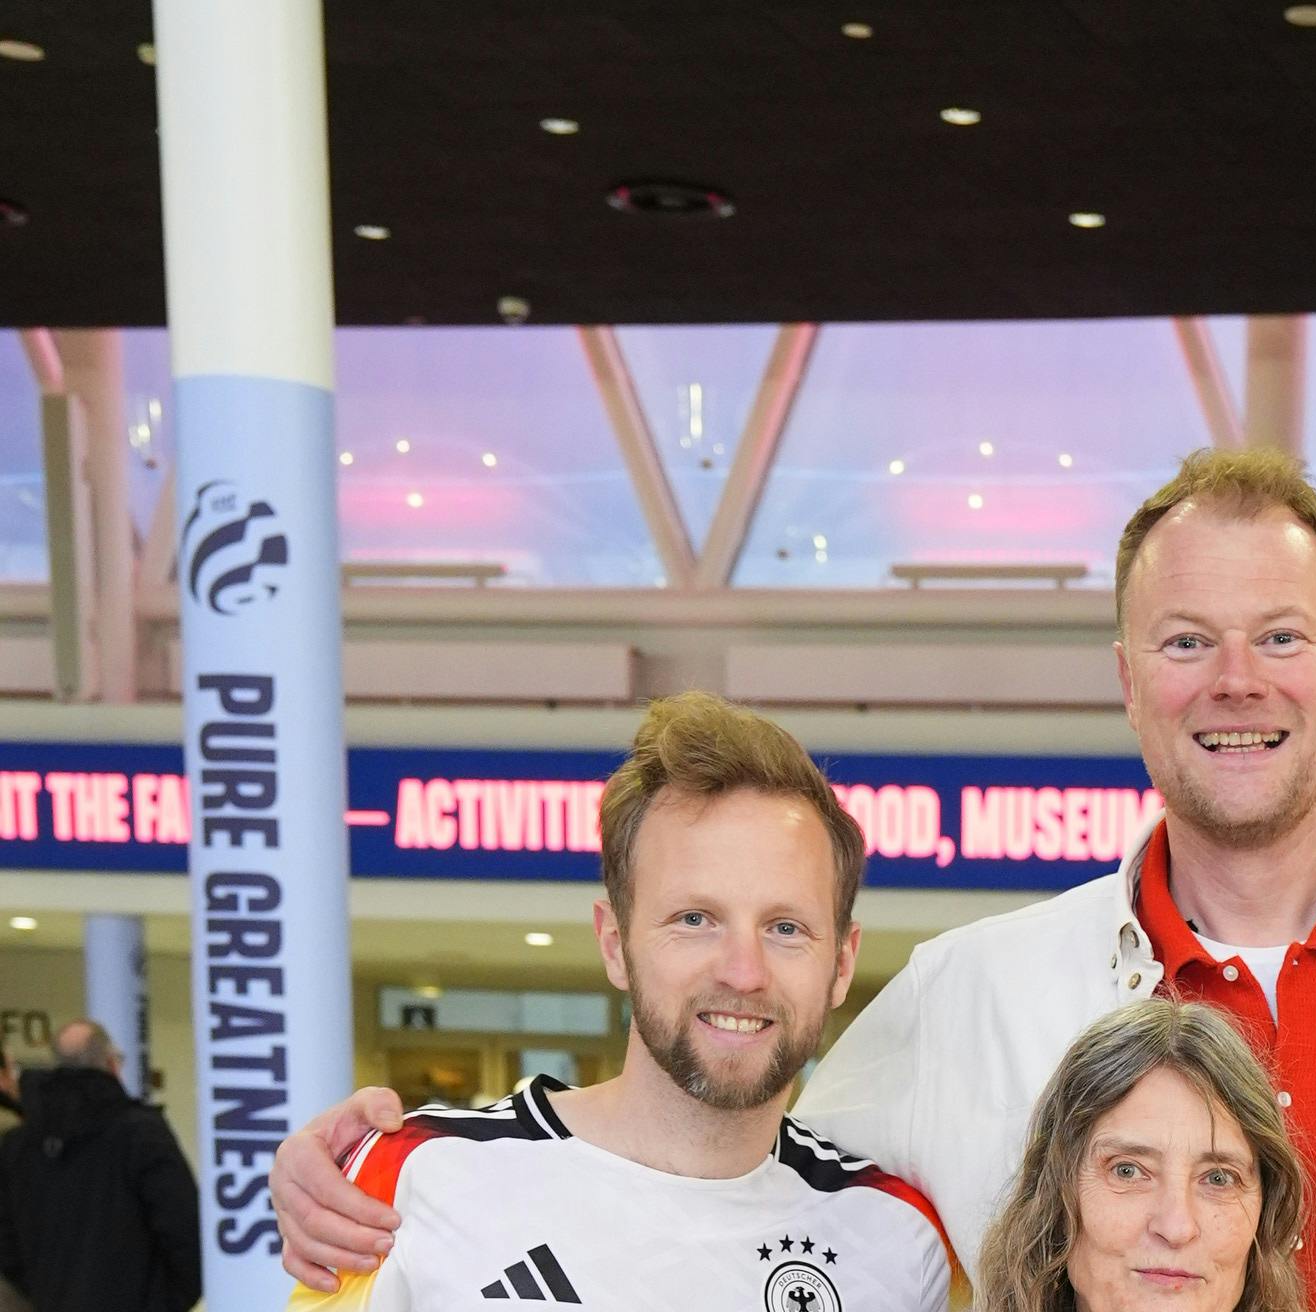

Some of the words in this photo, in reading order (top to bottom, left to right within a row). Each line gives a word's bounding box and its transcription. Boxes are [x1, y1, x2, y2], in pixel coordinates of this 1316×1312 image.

[45, 771, 130, 843] THE
[132, 773, 192, 844] FA
[395, 778, 606, 853] ACTIVITIE
[961, 786, 1165, 861] MUSEUM
[198, 674, 279, 848] PURE
[204, 871, 289, 1256] GREATNESS
[778, 1272, 822, 1289] DEUTSCHER
